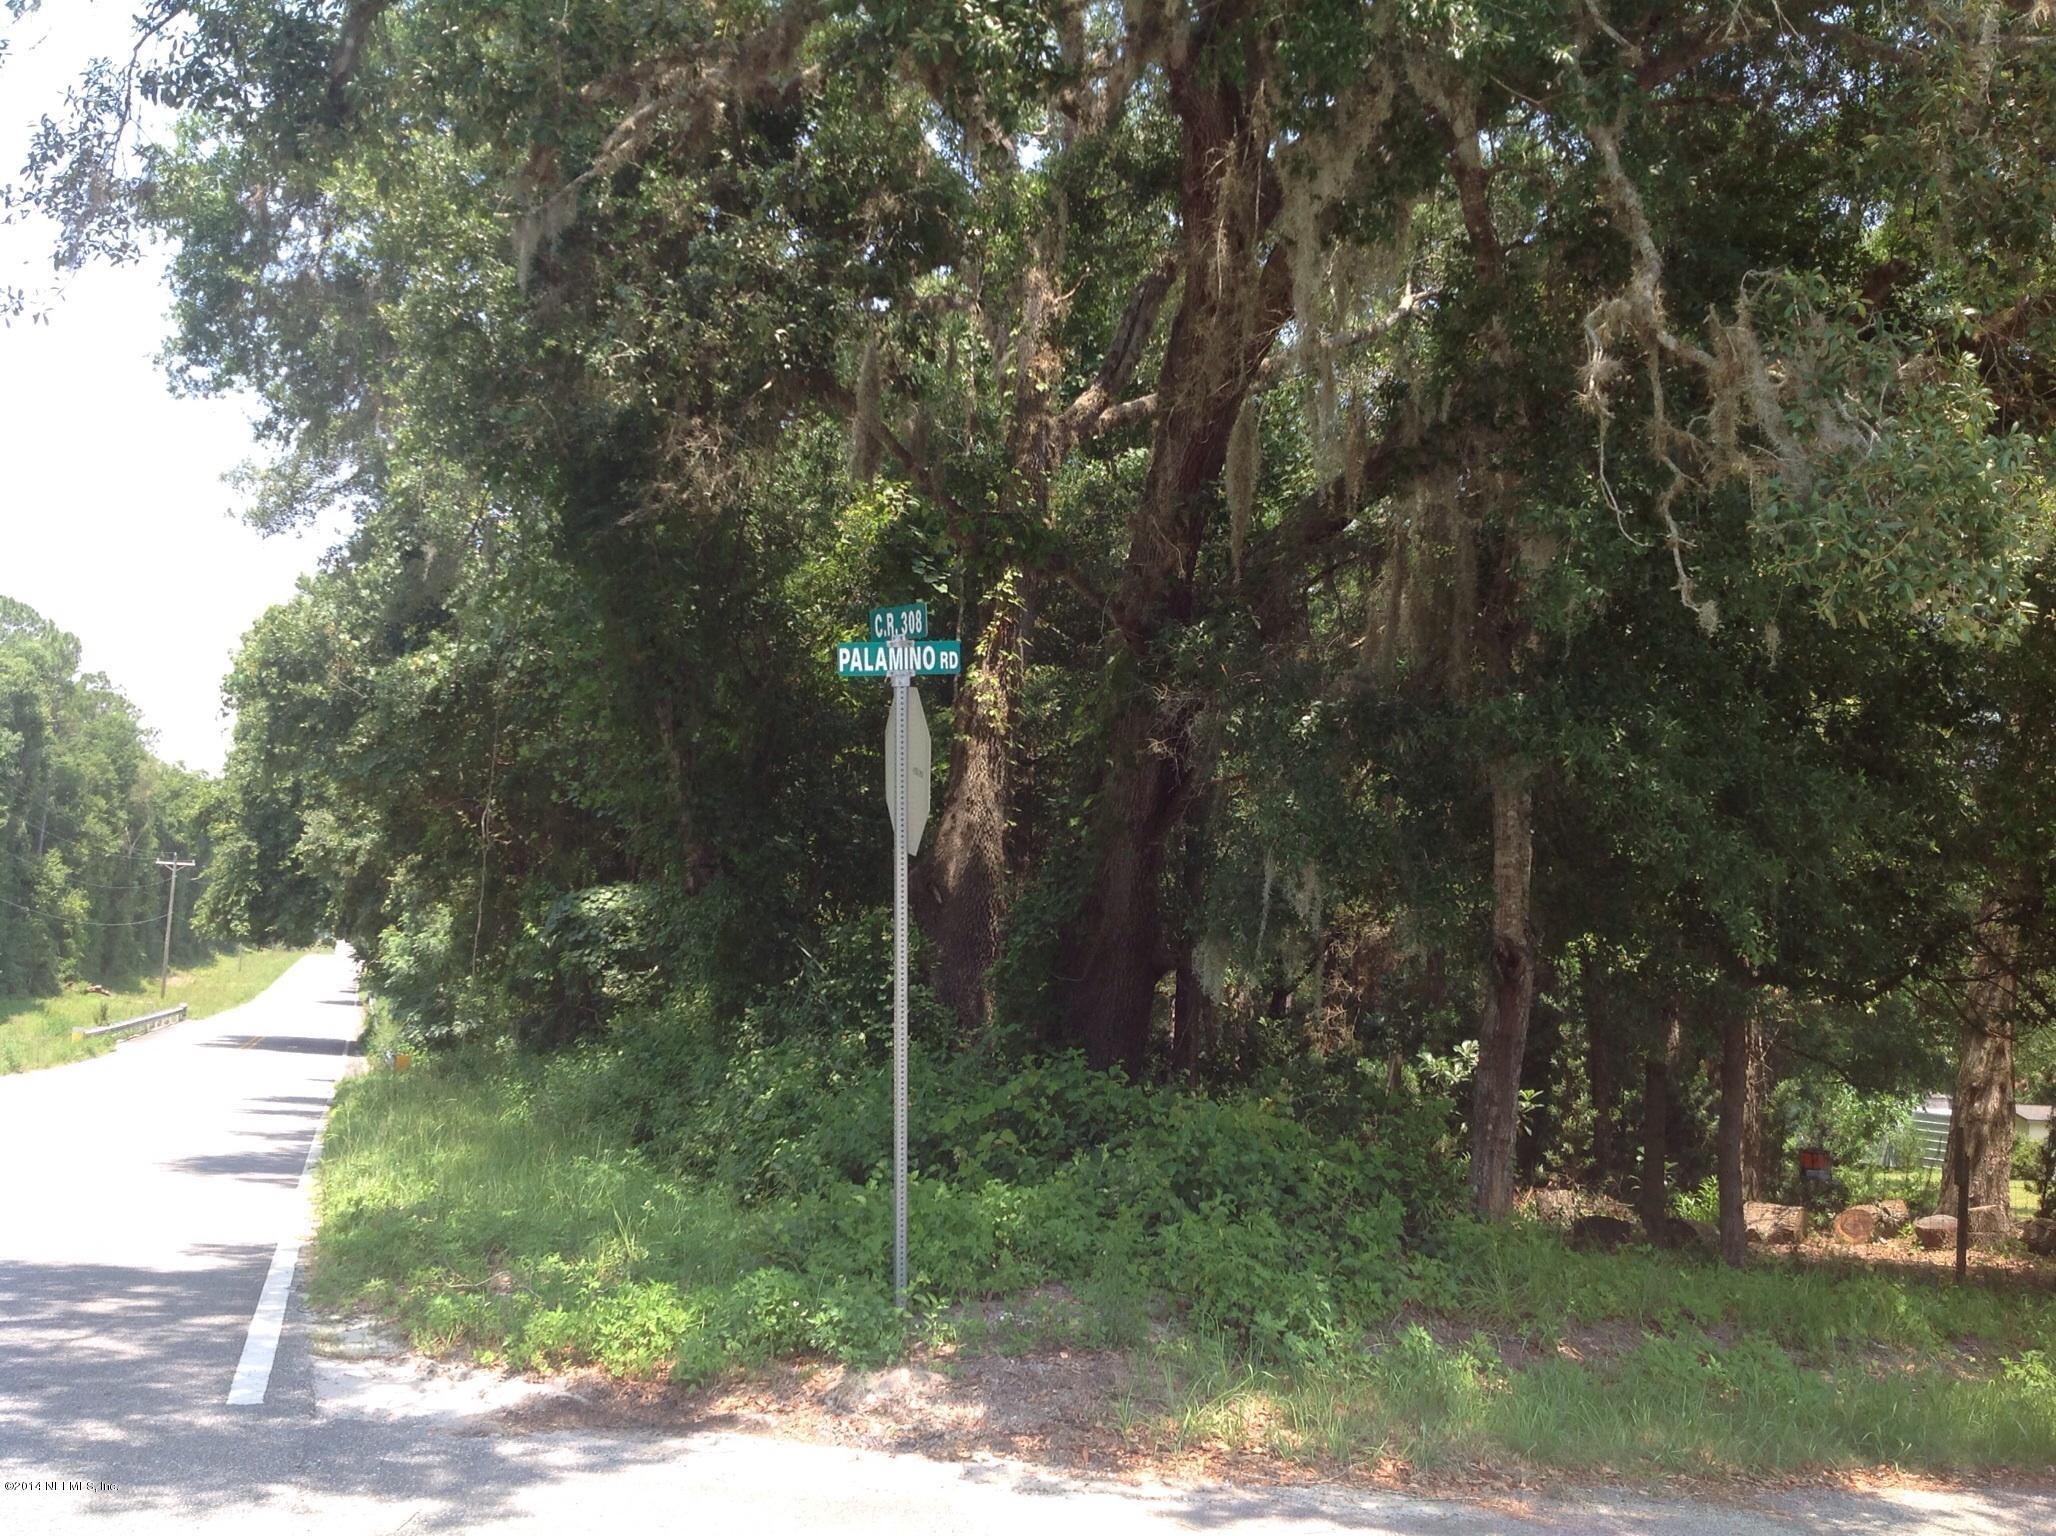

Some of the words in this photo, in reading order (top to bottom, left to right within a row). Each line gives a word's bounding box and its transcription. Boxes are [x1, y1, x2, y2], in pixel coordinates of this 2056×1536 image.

[875, 613, 898, 638] C.R.
[901, 609, 922, 634] 308
[839, 645, 936, 672] PALAMINO
[940, 651, 959, 670] RD
